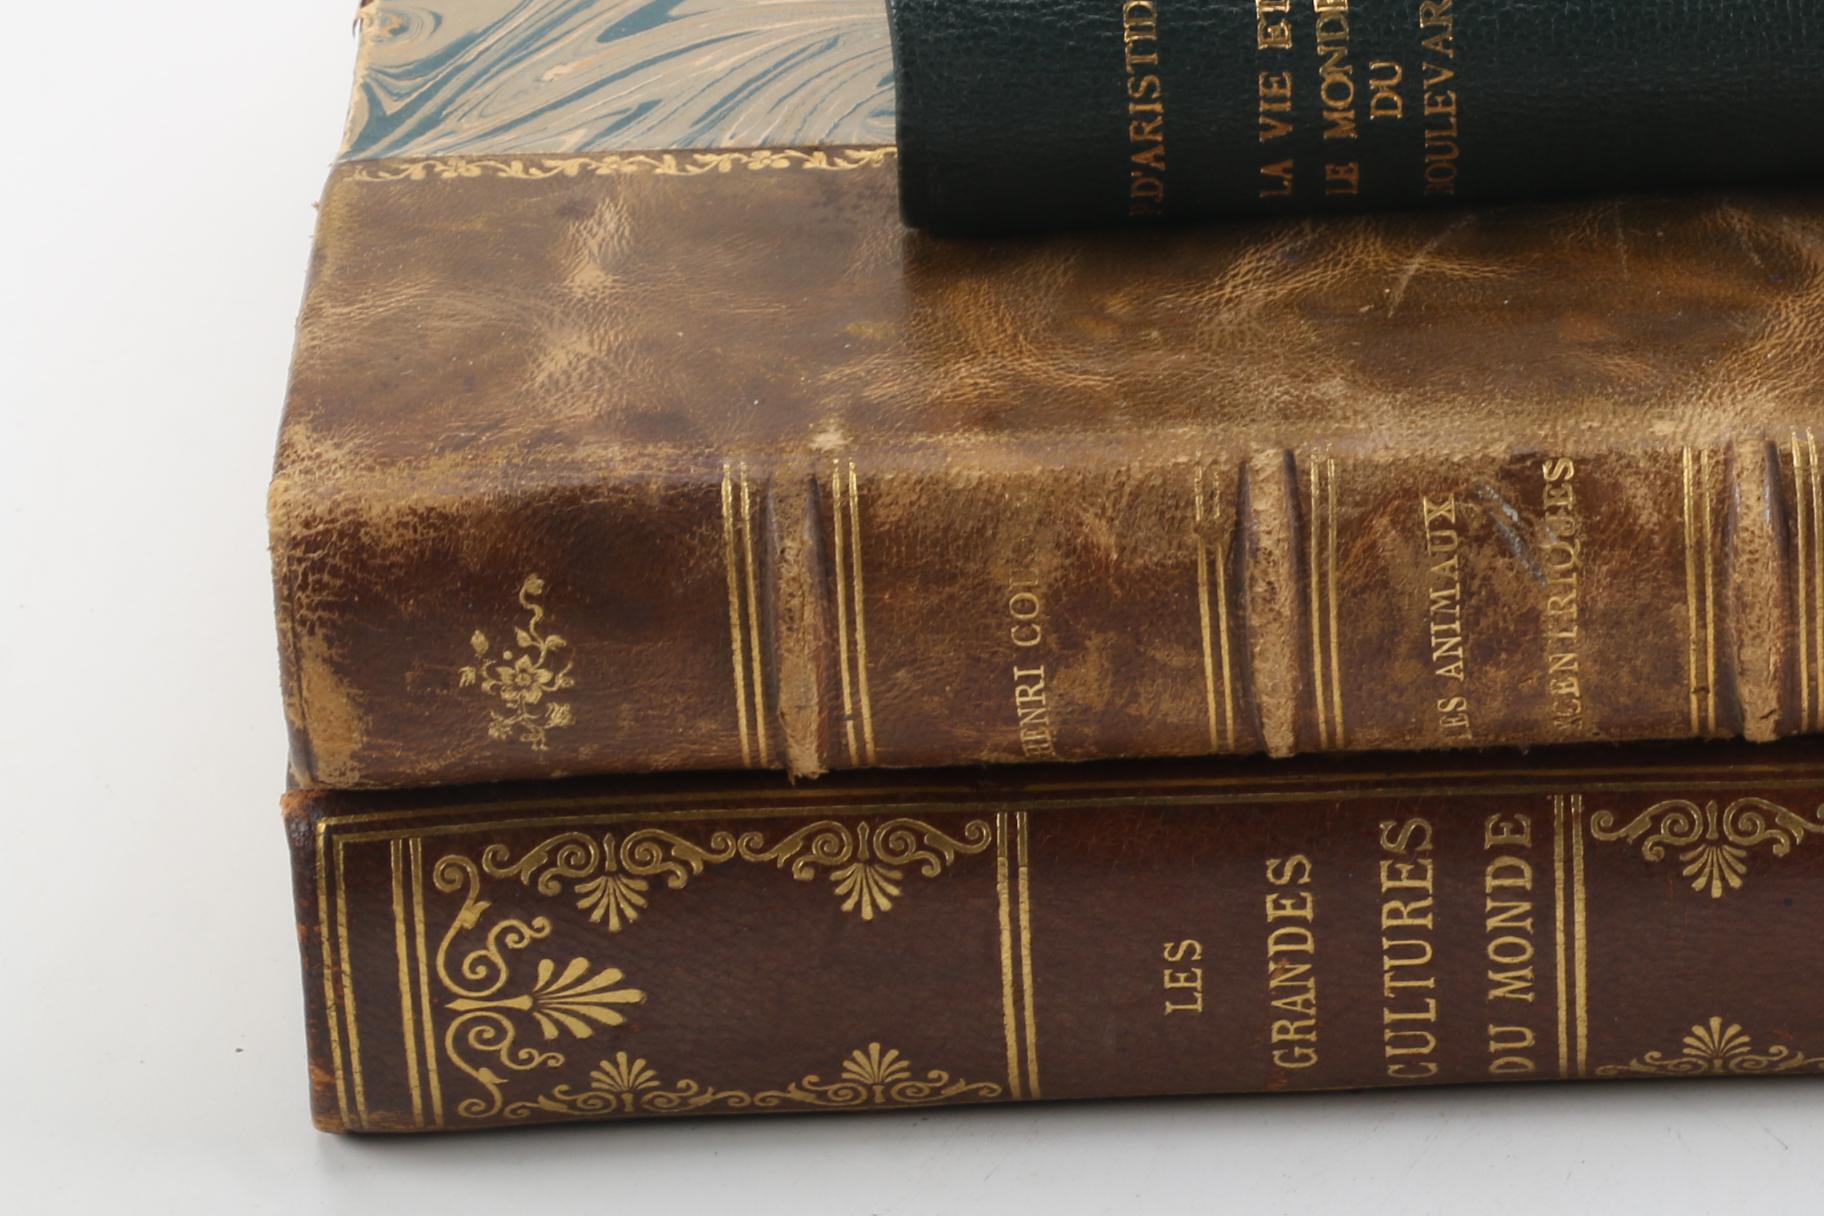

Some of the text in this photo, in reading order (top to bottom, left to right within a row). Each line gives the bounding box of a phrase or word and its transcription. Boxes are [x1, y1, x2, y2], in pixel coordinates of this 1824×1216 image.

[1258, 70, 1294, 143] VIE
[1368, 59, 1403, 121] DU
[1259, 158, 1295, 198] LA
[1325, 161, 1359, 196] LE
[1422, 492, 1464, 682] ANIMAUX
[1163, 937, 1203, 1016] LES
[1265, 852, 1319, 1070] GRANDES
[1379, 817, 1440, 1080] CULTURES
[1483, 812, 1536, 1075] DU MONDE
